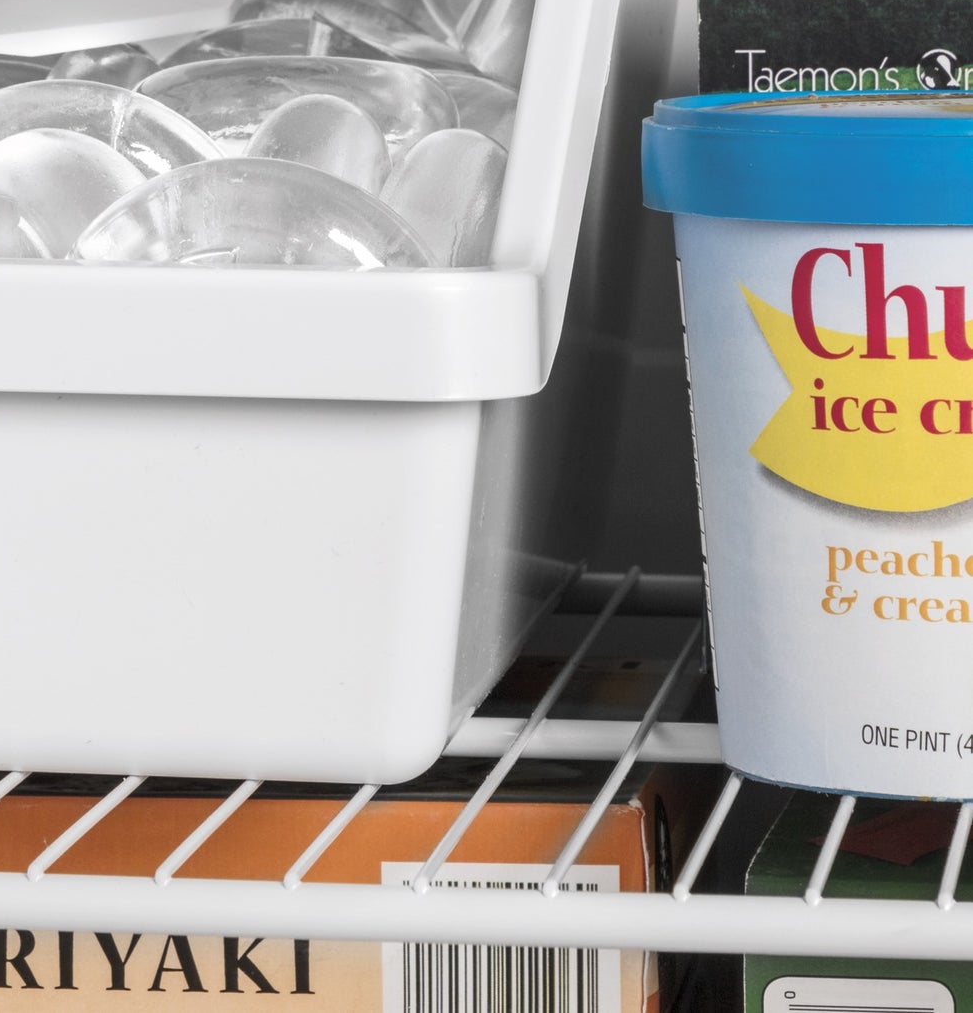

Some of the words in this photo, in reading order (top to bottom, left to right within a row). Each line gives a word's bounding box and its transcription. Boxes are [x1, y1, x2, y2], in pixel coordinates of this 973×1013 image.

[735, 49, 899, 93] Taemon's
[810, 377, 897, 434] ice
[821, 584, 858, 616] &
[873, 594, 973, 623] crea
[861, 724, 899, 748] ONE
[905, 729, 951, 752] PINT
